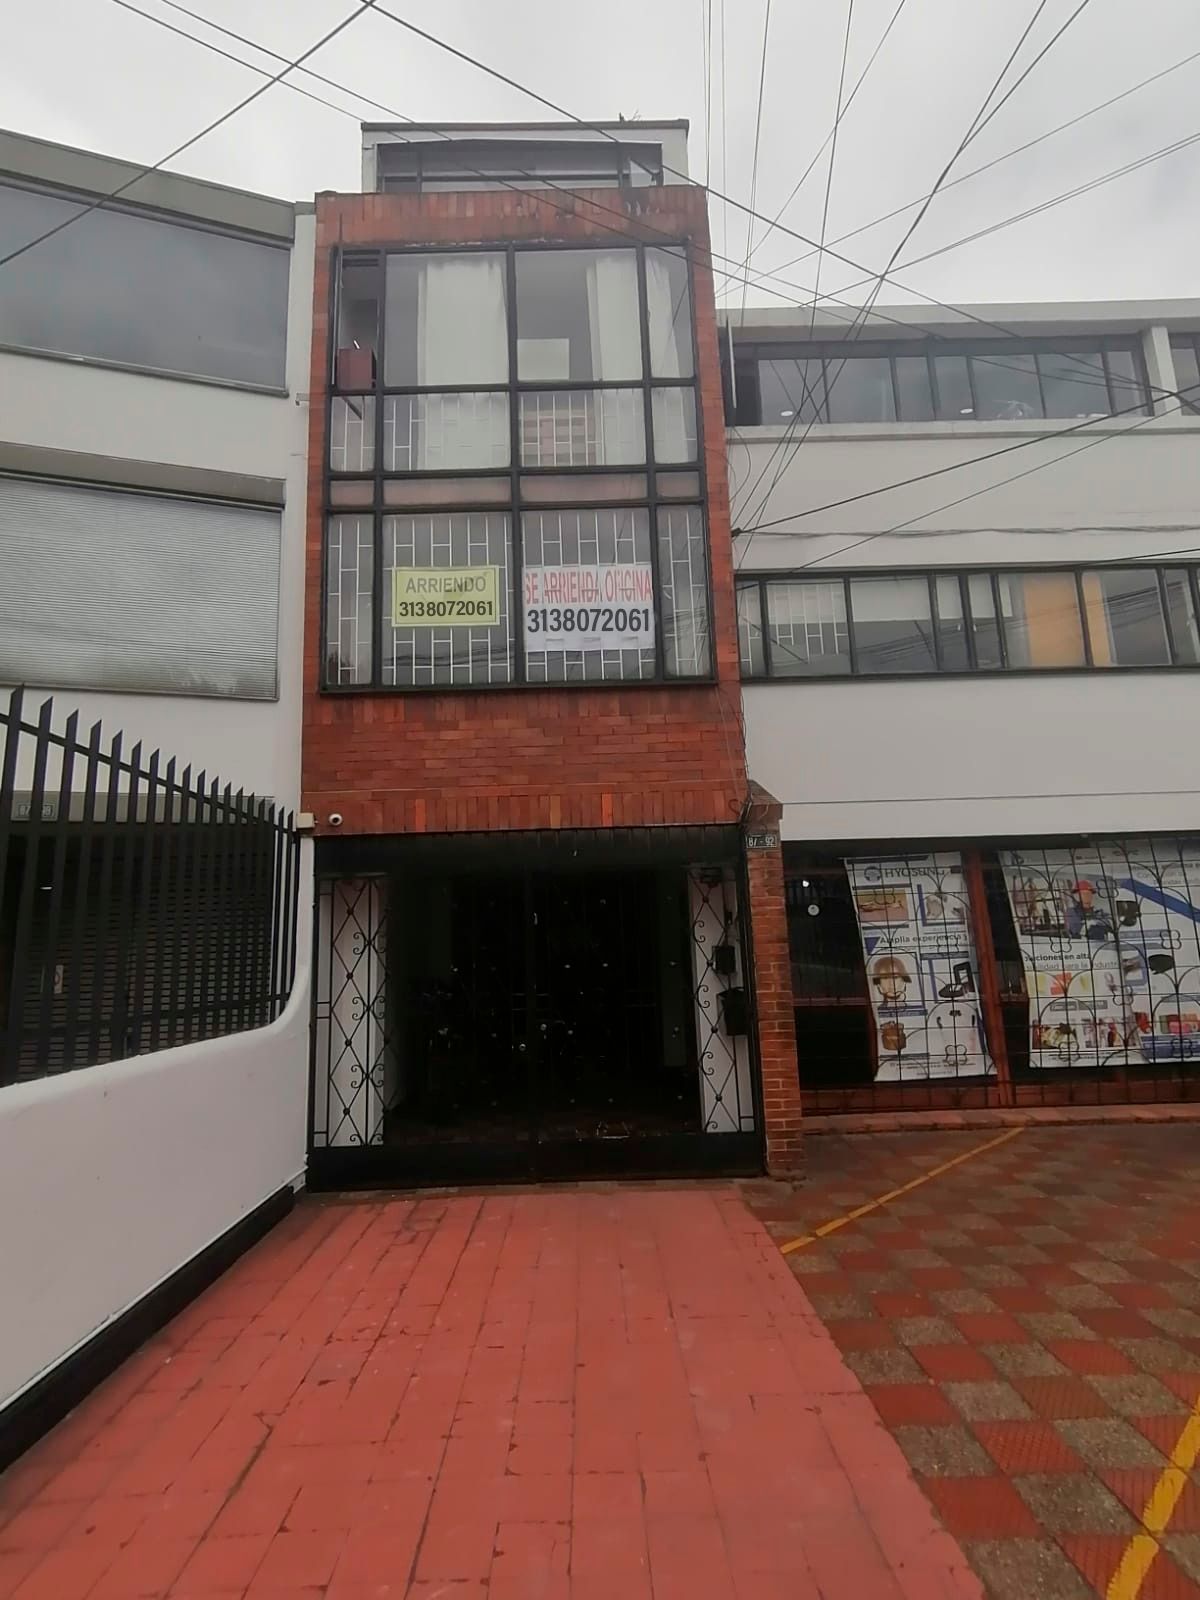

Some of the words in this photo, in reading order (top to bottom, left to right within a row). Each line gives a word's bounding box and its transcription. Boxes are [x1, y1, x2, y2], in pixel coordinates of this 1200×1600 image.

[405, 575, 486, 593] ARRIENDO
[399, 600, 493, 617] 3138072061
[527, 608, 650, 633] 3138072061
